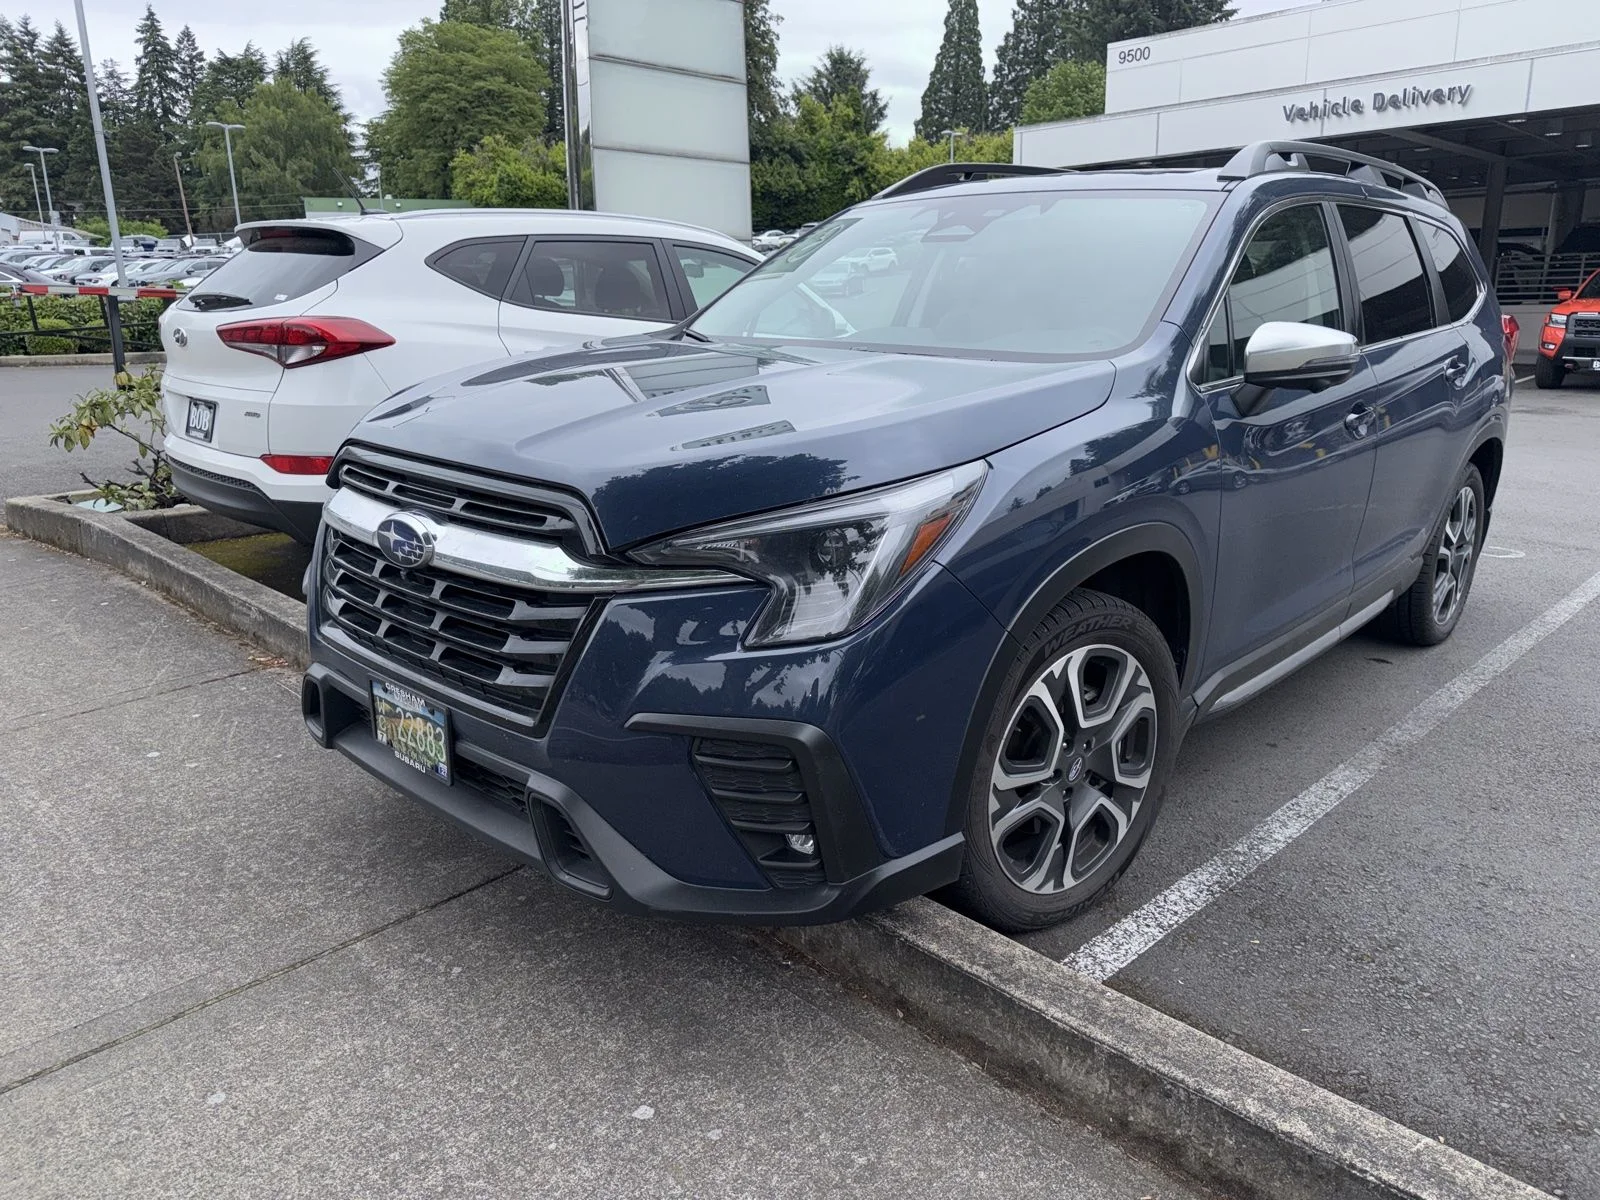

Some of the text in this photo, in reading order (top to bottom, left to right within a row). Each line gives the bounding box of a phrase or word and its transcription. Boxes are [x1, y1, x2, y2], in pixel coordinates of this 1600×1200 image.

[1118, 46, 1151, 64] 9500
[1282, 82, 1474, 123] Vehicle Delivery
[189, 407, 211, 431] BOB
[1044, 615, 1133, 659] WEATHER
[396, 707, 447, 762] 22883
[394, 750, 426, 773] SUBARU
